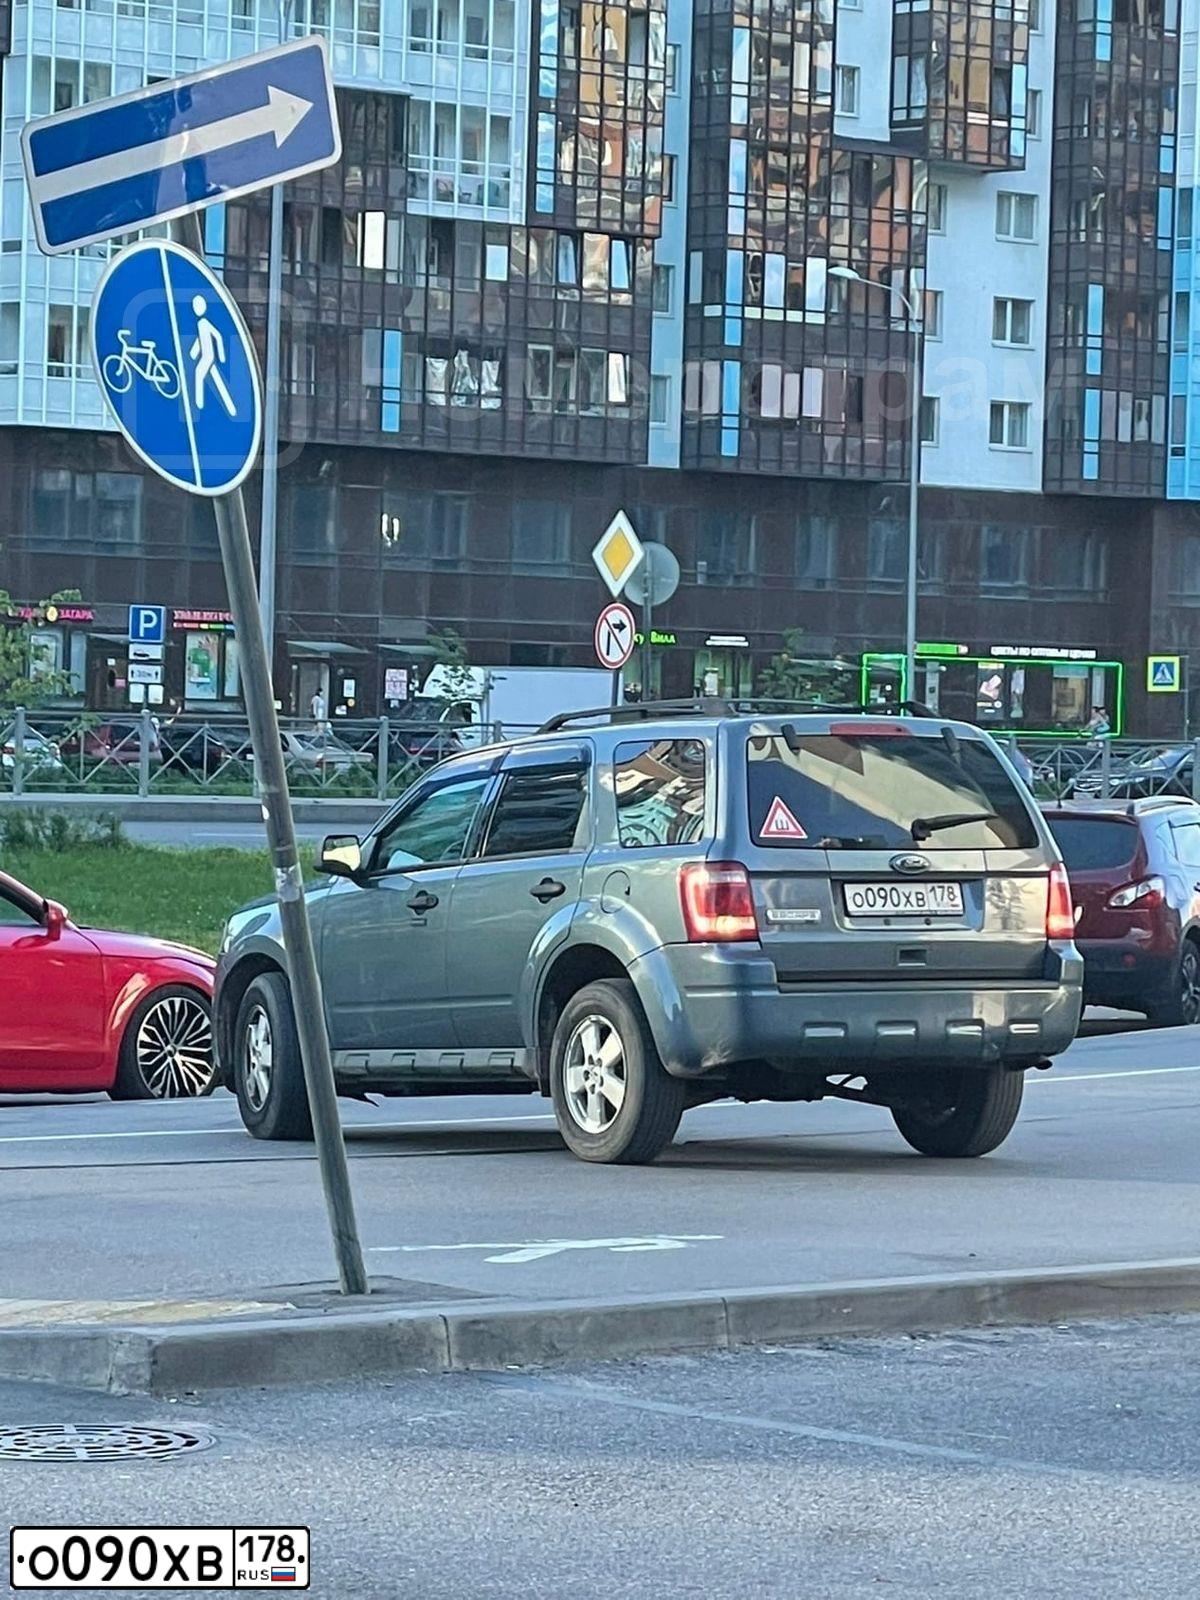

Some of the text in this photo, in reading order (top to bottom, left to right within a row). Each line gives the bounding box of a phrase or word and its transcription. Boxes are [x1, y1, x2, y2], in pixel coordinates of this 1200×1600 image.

[139, 609, 158, 637] P
[852, 885, 957, 908] О090ХВ 178
